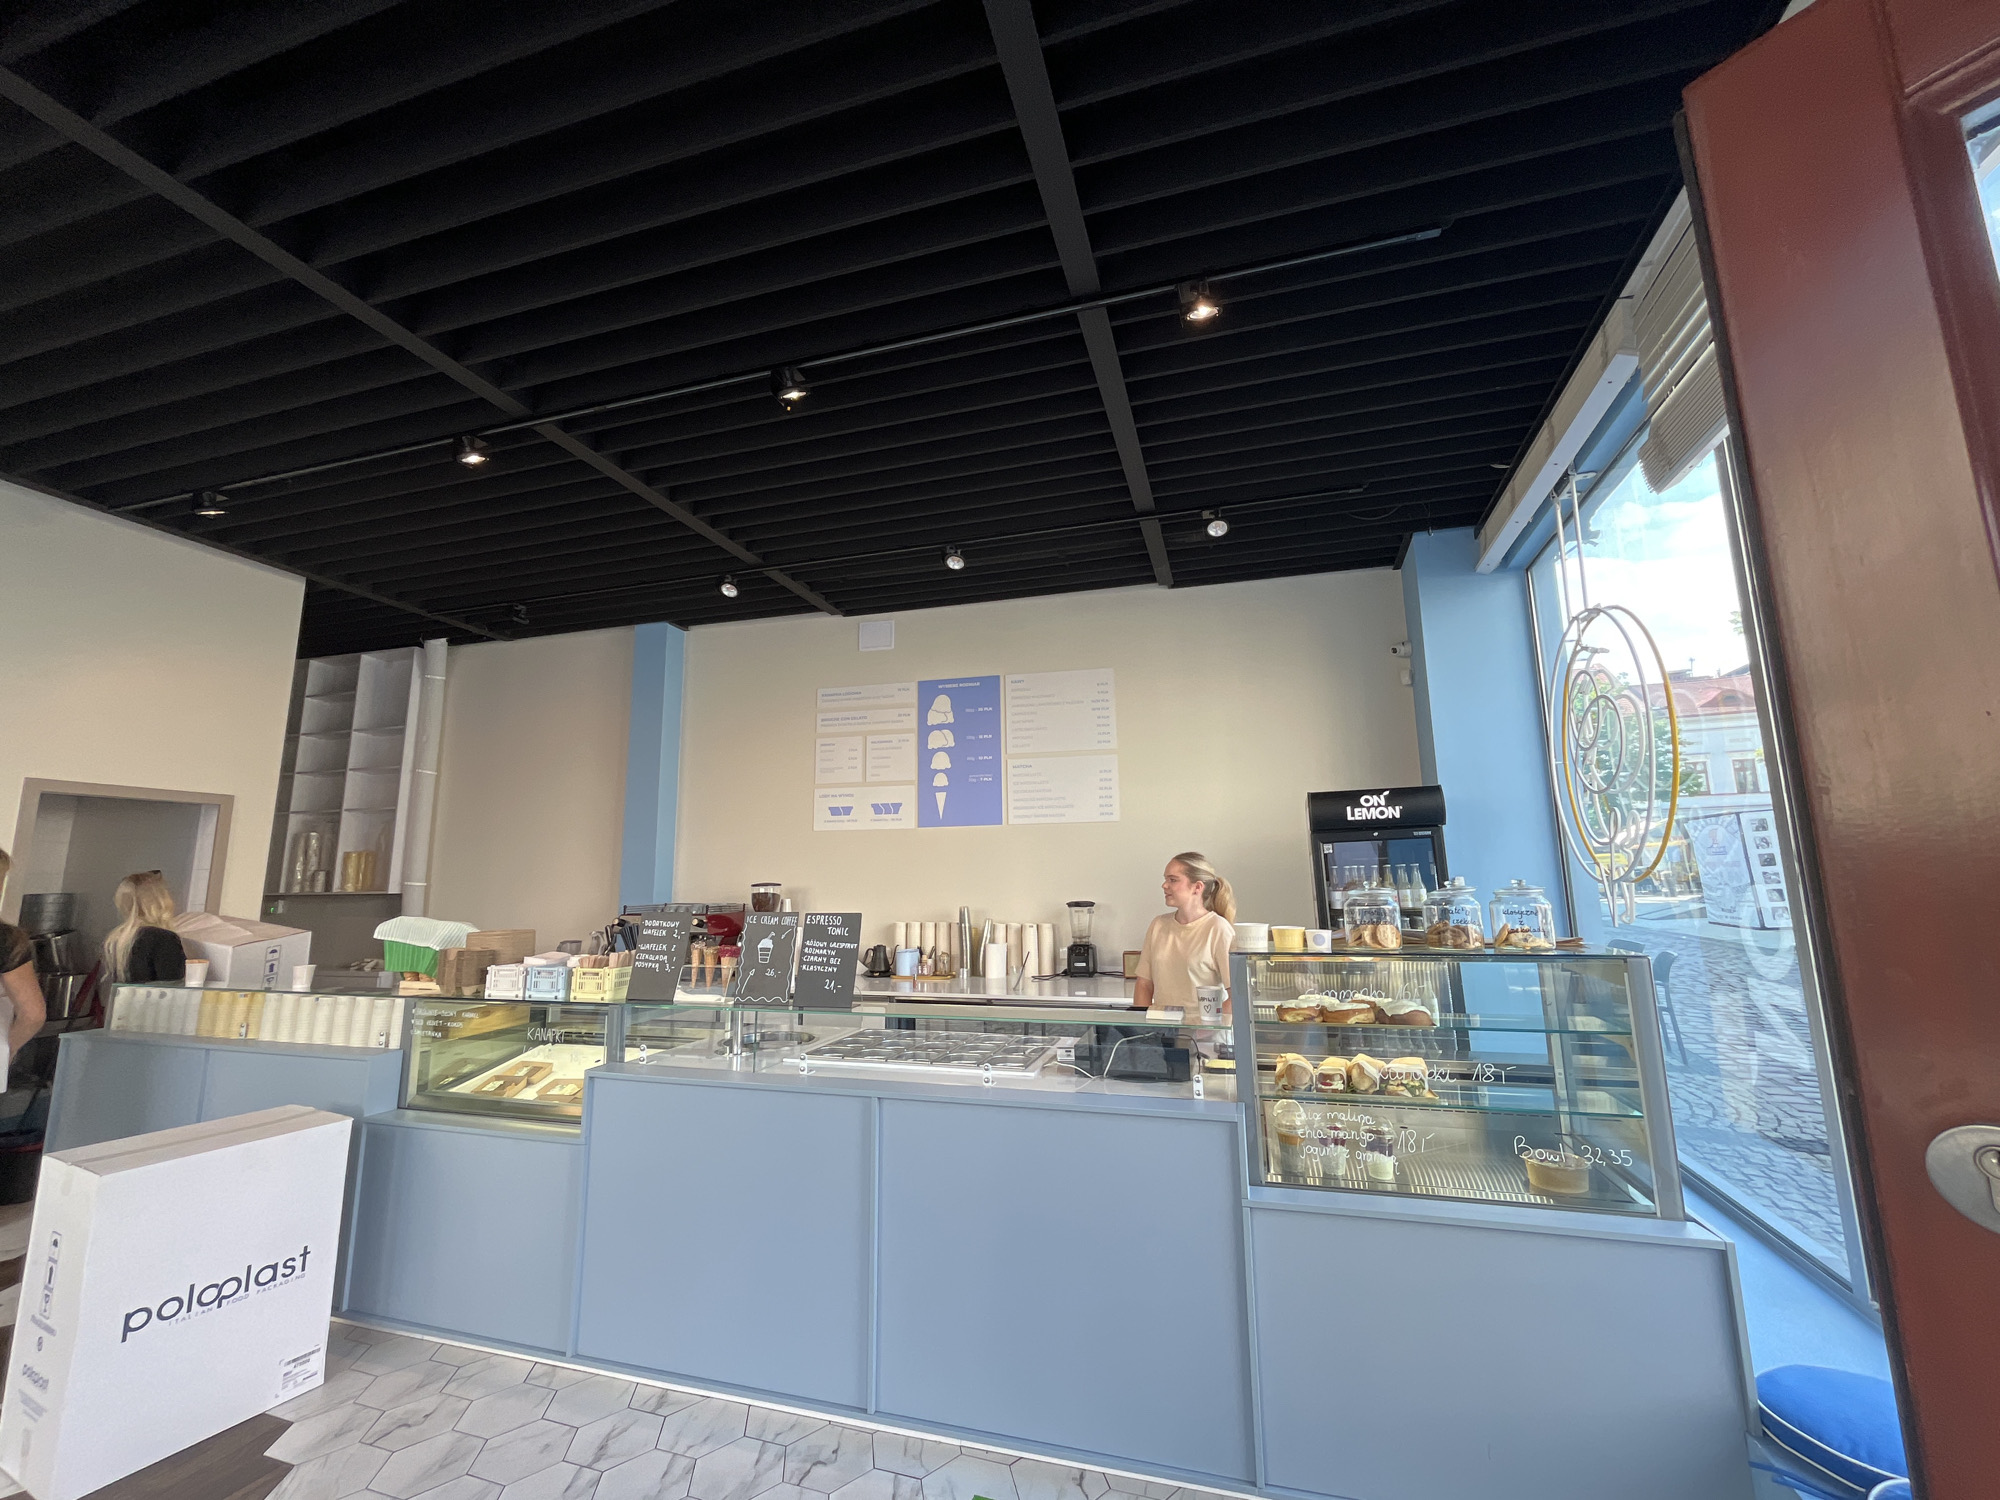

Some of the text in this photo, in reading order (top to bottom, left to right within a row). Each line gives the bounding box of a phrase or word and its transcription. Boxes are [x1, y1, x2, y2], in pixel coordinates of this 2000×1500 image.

[1360, 794, 1386, 807] ON
[1346, 805, 1401, 821] LEMON
[644, 920, 680, 928] DODATKOWY
[746, 915, 798, 926] ICE CREAM COFFEE
[806, 915, 842, 925] ESPRESSO
[643, 929, 667, 937] WAFELEK
[827, 927, 849, 936] TONIC
[804, 947, 837, 956] ROZMARYN
[635, 961, 659, 972] POSYPKĄ
[803, 955, 841, 965] CZARNY BEZ
[802, 964, 838, 973] KLASYCZNY
[527, 1027, 565, 1044] KANAPKI
[1327, 1109, 1376, 1125] malina
[1298, 1128, 1375, 1147] chia mango
[1513, 1135, 1565, 1164] Bowl
[256, 1273, 306, 1295] PACKAGING
[120, 1245, 311, 1343] poloplast
[226, 1293, 250, 1306] FOOD
[169, 1307, 213, 1326] ITALIAN
